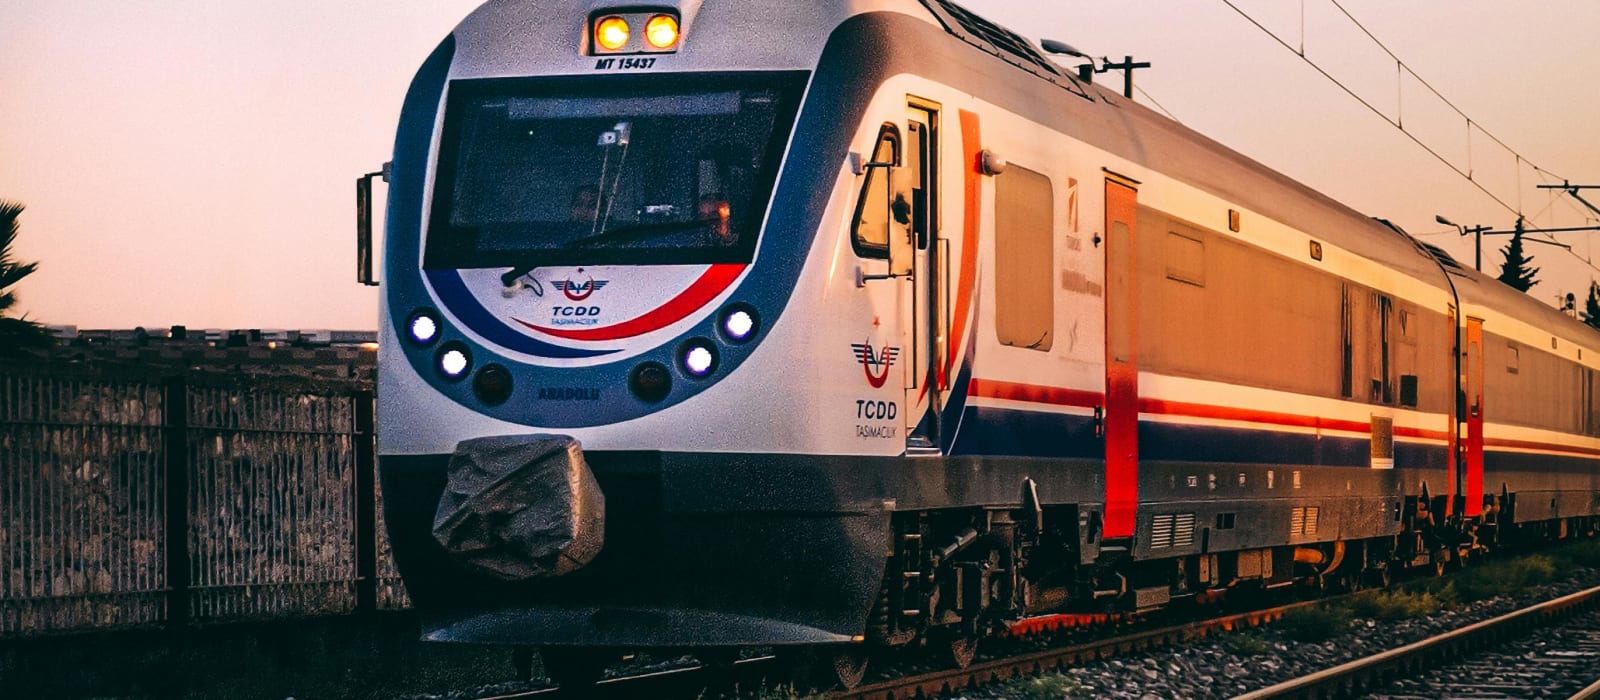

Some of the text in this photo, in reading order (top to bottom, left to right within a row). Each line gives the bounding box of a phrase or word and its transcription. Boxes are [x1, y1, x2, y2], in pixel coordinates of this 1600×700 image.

[595, 57, 657, 70] MT 15437
[552, 306, 601, 316] TCDD
[856, 399, 897, 420] TCDD
